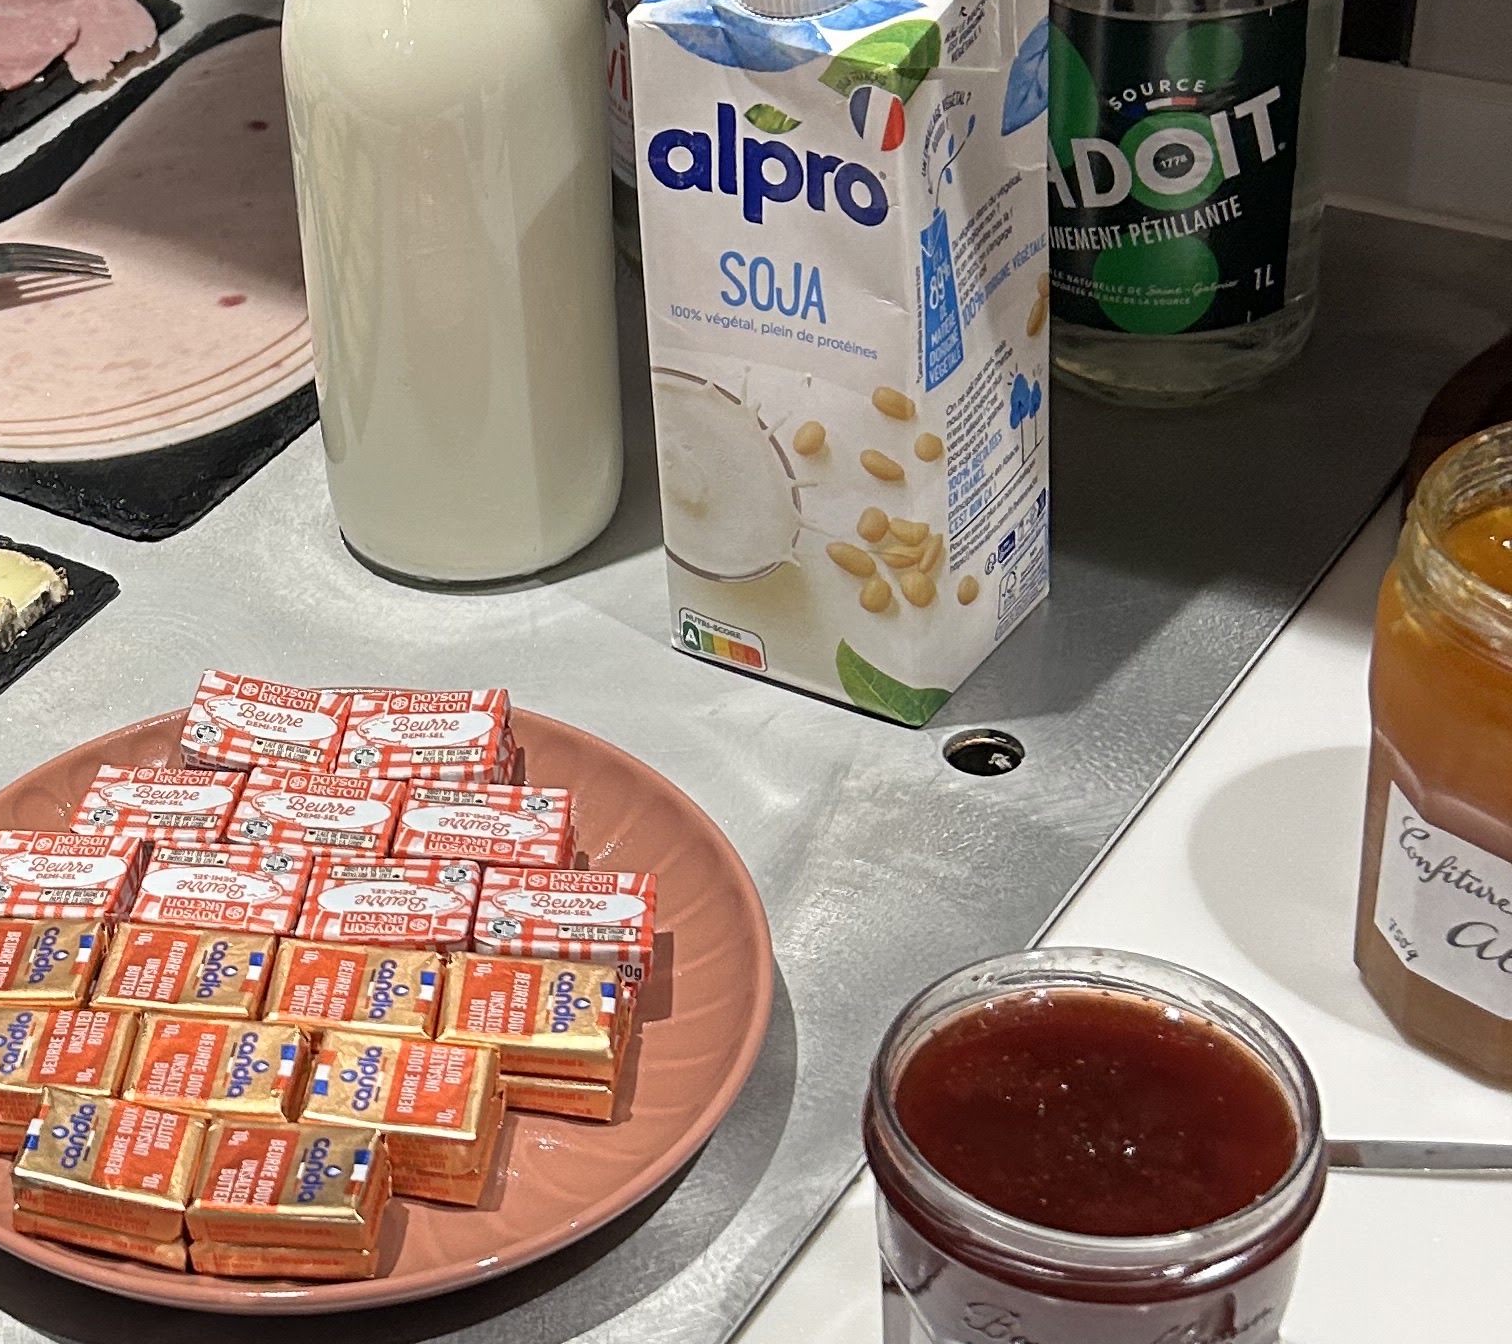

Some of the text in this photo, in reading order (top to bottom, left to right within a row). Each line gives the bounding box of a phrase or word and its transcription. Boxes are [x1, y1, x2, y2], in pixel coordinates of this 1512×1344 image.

[1109, 78, 1206, 111] SOURCE
[647, 102, 889, 227] alpro
[1048, 86, 1281, 209] ADOIT
[1049, 225, 1122, 251] INEMENT
[1129, 194, 1243, 246] PÉTILLANTE
[719, 250, 827, 325] SOJA
[670, 304, 878, 361] 100% végétal, plein de protéines
[685, 628, 698, 646] A
[237, 703, 303, 728] Beurre
[258, 693, 314, 712] BRETON
[410, 701, 467, 712] BRETON
[246, 720, 287, 733] DEMI-SEL
[391, 716, 460, 732] Beurre
[132, 785, 200, 800] Beurre
[154, 774, 210, 785] BRETON
[307, 784, 365, 799] BRETON
[286, 795, 355, 816] Beurre
[296, 812, 340, 822] DEMI-SEL
[429, 832, 491, 846] BRETON
[439, 817, 512, 837] Beurre
[28, 857, 94, 873] Beurre
[51, 844, 106, 855] BRETON
[1399, 816, 1512, 915] Confiture
[177, 880, 247, 899] Beurre
[193, 873, 237, 883] DEMI-SEL
[549, 881, 613, 893] BRETON
[166, 898, 225, 912] BRETON
[346, 913, 408, 925] BRETON
[355, 894, 428, 912] Beurre
[531, 893, 608, 911] Beurre
[543, 909, 592, 917] DEMI-SEL
[27, 926, 60, 984] candia
[155, 940, 188, 1000] BEURRE DOUX
[196, 941, 229, 998] candia
[618, 964, 642, 980] 10g
[117, 965, 142, 996] BUTTER
[135, 957, 161, 998] UNSALTED
[333, 959, 356, 996] BEURRE
[368, 959, 398, 1020] candia
[511, 971, 532, 1010] BEURRE
[551, 971, 576, 1033] candia
[39, 1009, 75, 1075] BEURRE DOUX
[67, 1010, 94, 1054] UNSALTED
[87, 1011, 111, 1046] BUTTER
[192, 1033, 217, 1073] BEURRE
[227, 1031, 259, 1098] candia
[423, 1046, 449, 1093] UNSALTED
[443, 1047, 467, 1085] BUTTER
[351, 1045, 383, 1111] candia
[396, 1044, 427, 1114] BEURRE DOUX
[60, 1103, 97, 1169] candia
[103, 1106, 140, 1175] BEURRE DOUX
[132, 1109, 161, 1157] UNSALTED
[153, 1112, 179, 1150] BUTTER
[212, 1168, 238, 1203] BUTTER
[230, 1159, 259, 1205] UNSALTED
[252, 1138, 288, 1206] BEURRE DOUX
[296, 1136, 331, 1203] candia
